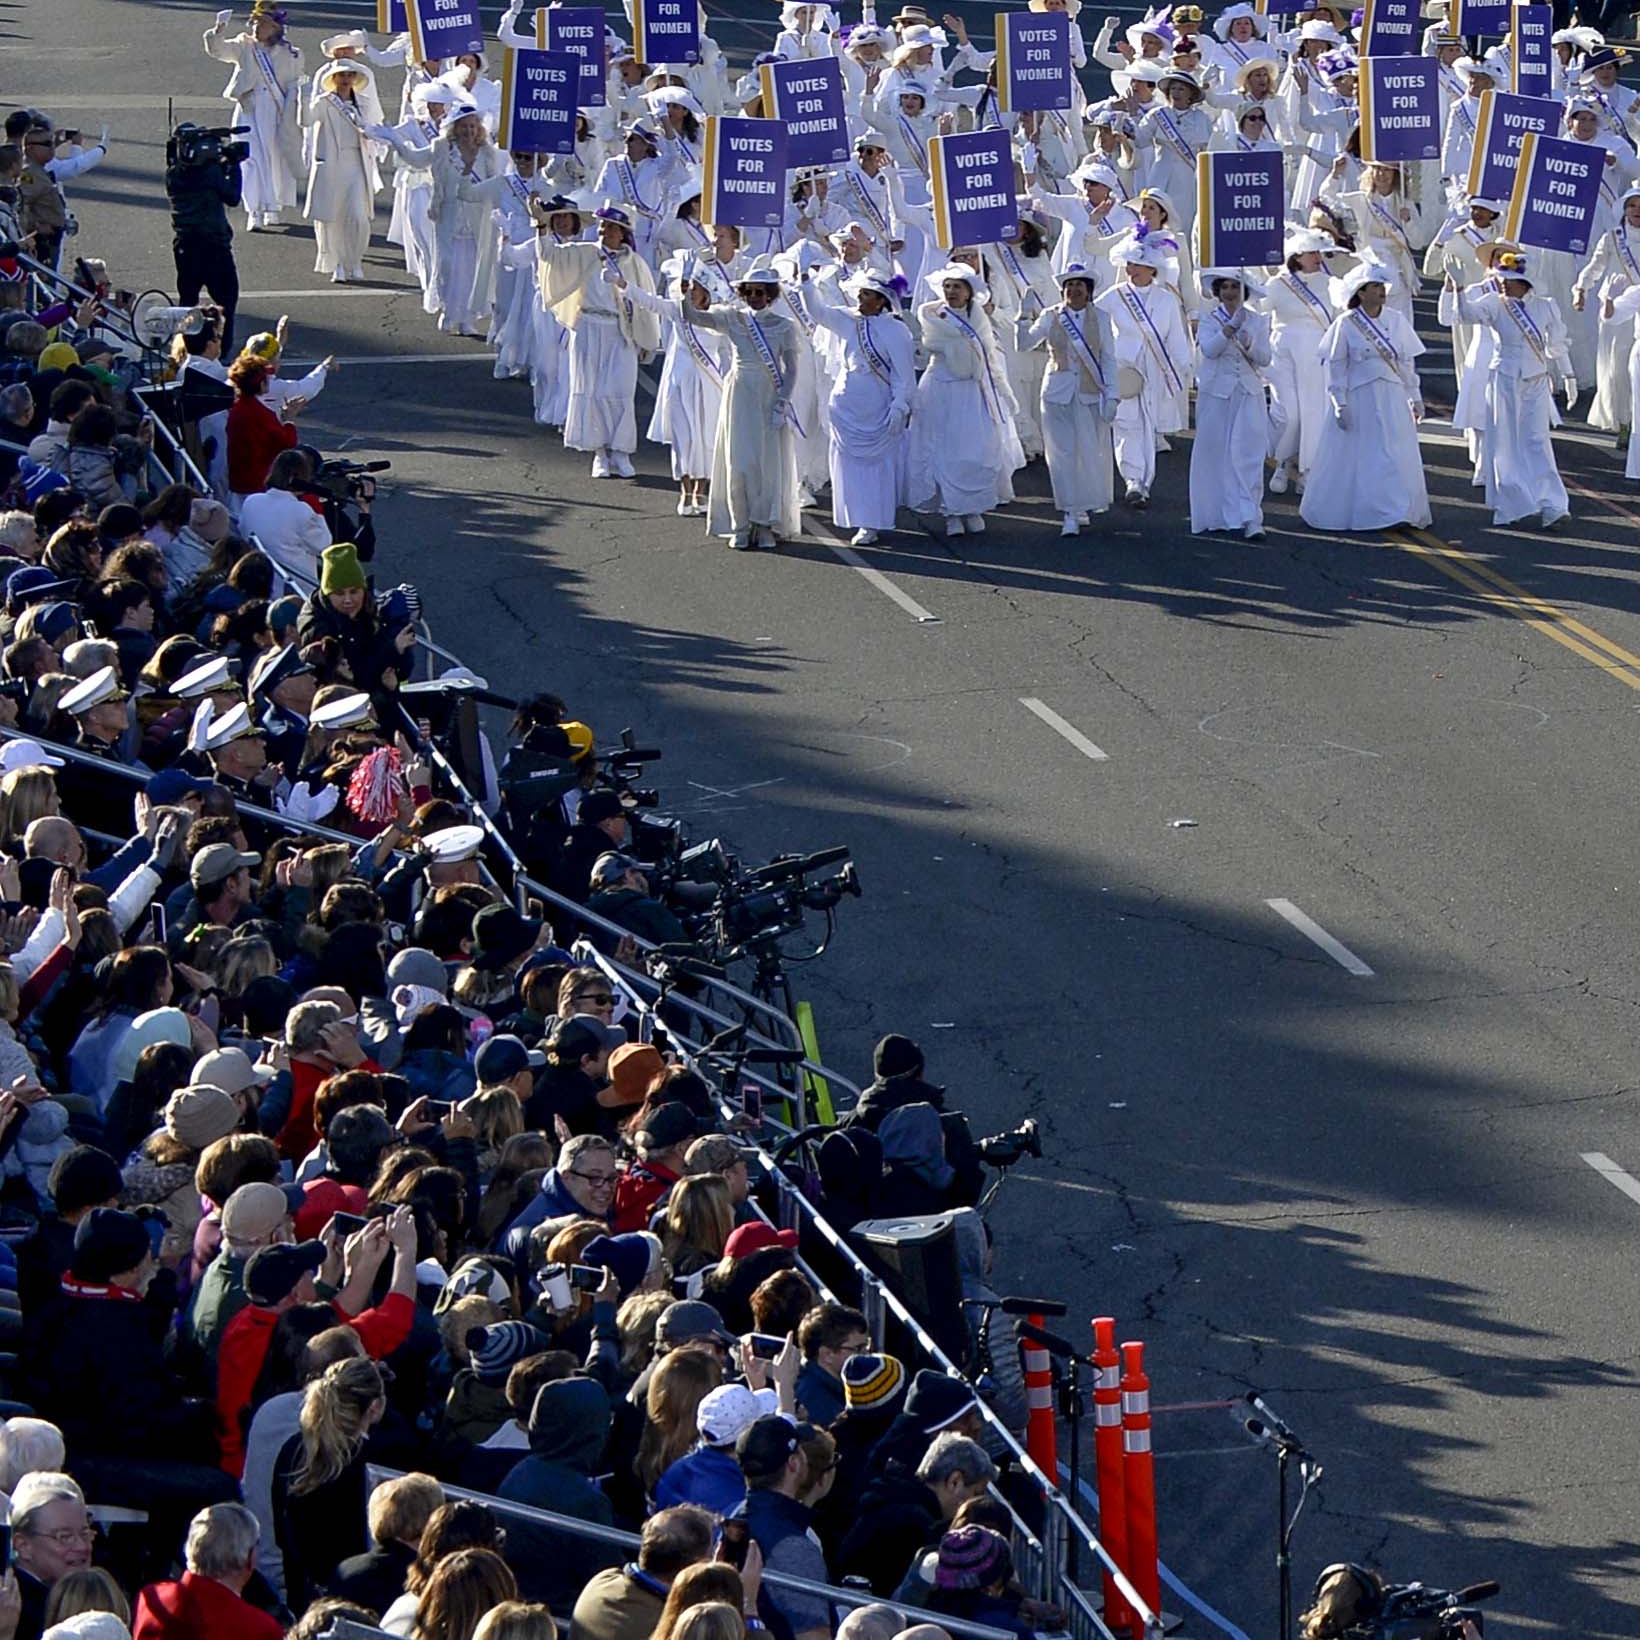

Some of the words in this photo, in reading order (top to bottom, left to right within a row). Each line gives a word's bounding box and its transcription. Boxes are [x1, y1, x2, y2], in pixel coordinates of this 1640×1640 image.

[658, 3, 680, 15] FOR
[1387, 4, 1406, 16] FOR
[426, 14, 472, 31] WOMEN
[649, 22, 691, 34] WOMEN
[1376, 22, 1413, 34] WOMEN
[1522, 23, 1545, 36] VOTES
[558, 26, 594, 38] VOTES
[1018, 30, 1058, 42] VOTES
[1026, 48, 1050, 61] FOR
[1525, 42, 1540, 55] FOR
[526, 68, 566, 82] VOTES
[1016, 68, 1062, 81] WOMEN
[1520, 63, 1547, 75] WOMEN
[786, 78, 828, 94] VOTES
[1383, 76, 1426, 88] VOTES
[532, 88, 558, 102] FOR
[1392, 96, 1418, 109] FOR
[796, 99, 824, 114] FOR
[519, 107, 568, 122] WOMEN
[1380, 114, 1432, 129] WOMEN
[1503, 113, 1546, 131] VOTES
[787, 117, 838, 135] WOMEN
[730, 137, 773, 152] VOTES
[1508, 134, 1523, 149] FO
[736, 159, 764, 173] FOR
[955, 151, 999, 169] VOTES
[1545, 157, 1589, 177] VOTES
[723, 179, 776, 194] WOMEN
[966, 174, 992, 189] FOR
[1224, 172, 1270, 187] VOTES
[1549, 180, 1576, 197] FOR
[954, 193, 1008, 212] WOMEN
[1234, 194, 1262, 209] FOR
[1532, 199, 1586, 220] WOMEN
[1220, 216, 1275, 232] WOMEN
